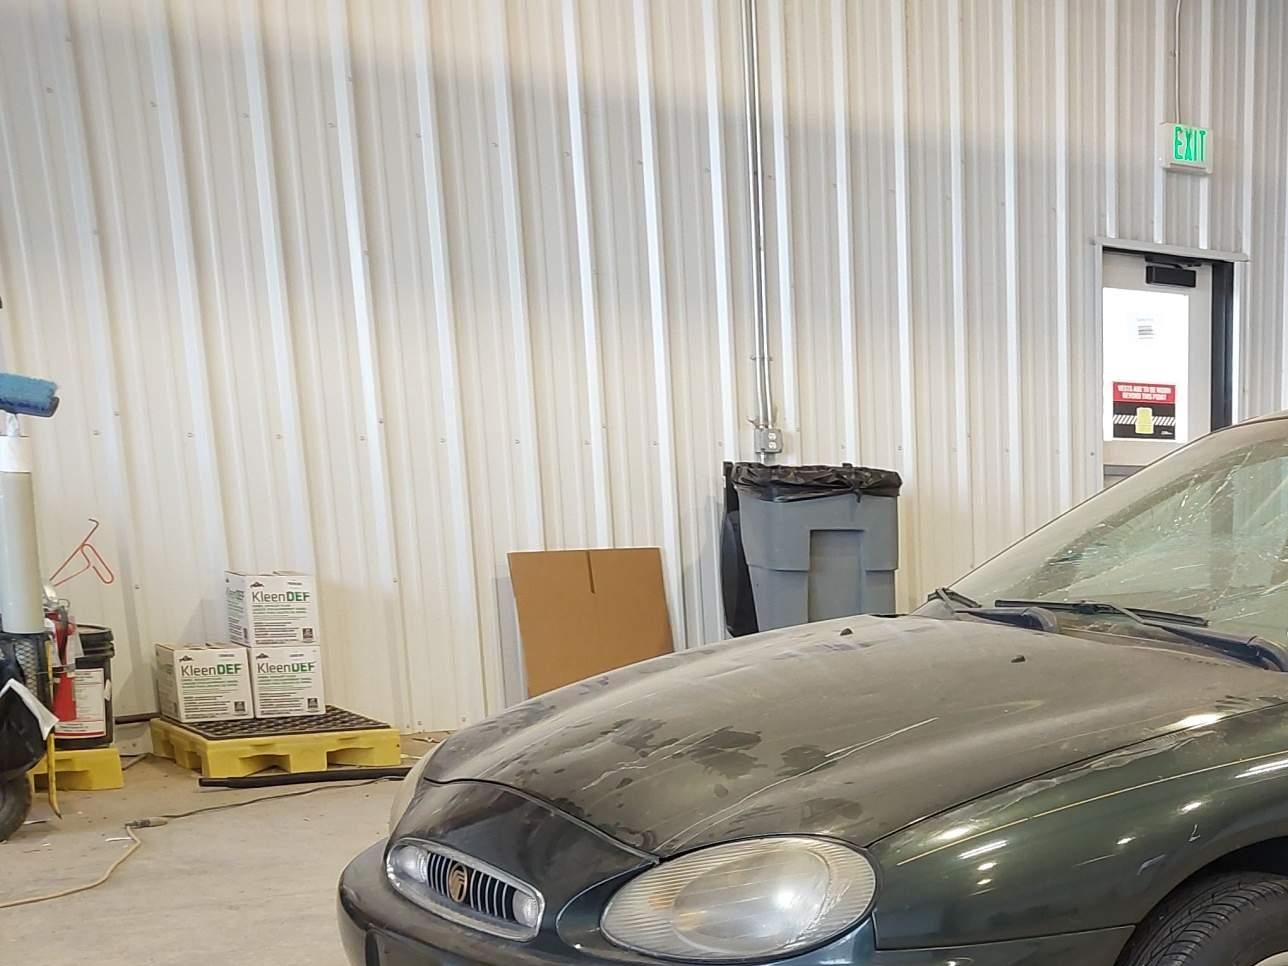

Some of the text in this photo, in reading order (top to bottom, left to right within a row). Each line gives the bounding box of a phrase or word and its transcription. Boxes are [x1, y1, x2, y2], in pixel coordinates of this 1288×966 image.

[1174, 126, 1206, 161] EXIT
[251, 591, 311, 603] KleenDEF
[180, 662, 243, 676] KleenDEF
[256, 662, 316, 673] KleenDEF
